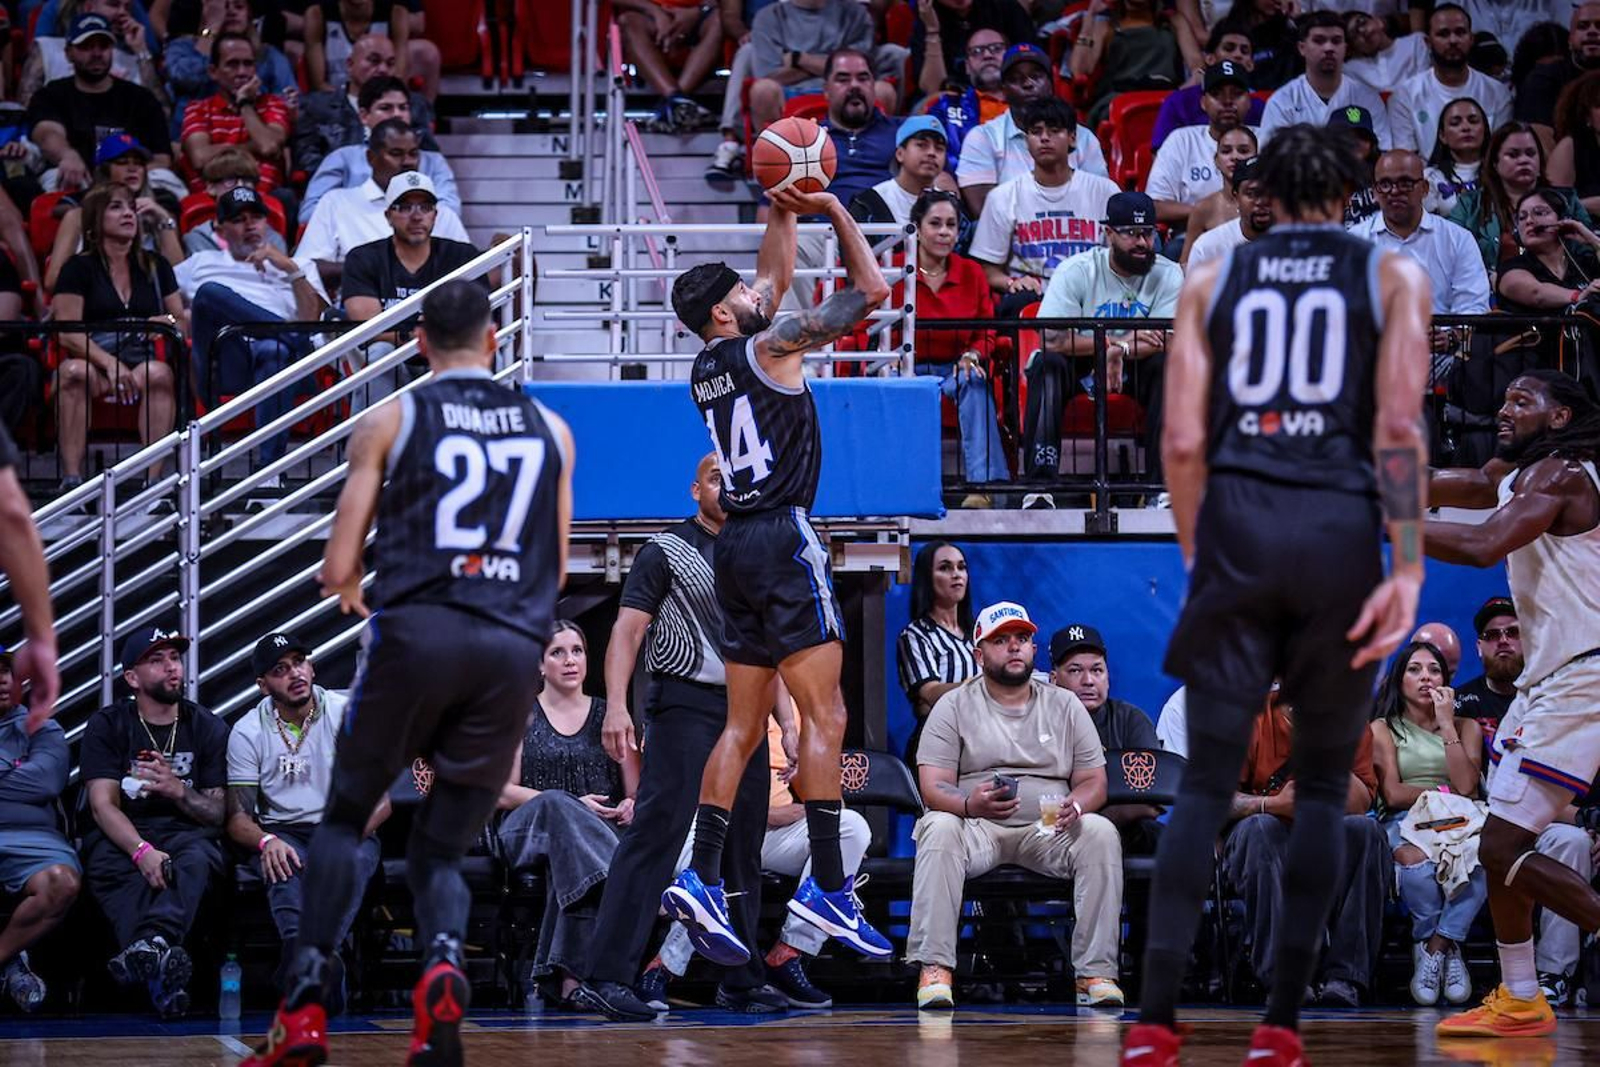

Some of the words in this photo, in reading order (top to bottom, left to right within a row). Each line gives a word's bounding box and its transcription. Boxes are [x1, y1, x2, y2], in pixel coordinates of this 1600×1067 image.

[1222, 61, 1234, 75] S
[552, 137, 568, 152] N
[1190, 166, 1212, 181] 80
[565, 183, 583, 199] M
[1014, 218, 1096, 244] HARLEM
[599, 282, 612, 299] K
[1228, 287, 1347, 406] 00
[694, 372, 736, 403] MOJICA
[441, 403, 525, 434] DUARTE
[1237, 410, 1325, 437] GOYA
[705, 394, 773, 492] 14
[435, 434, 545, 552] 27
[1068, 626, 1084, 640] NY
